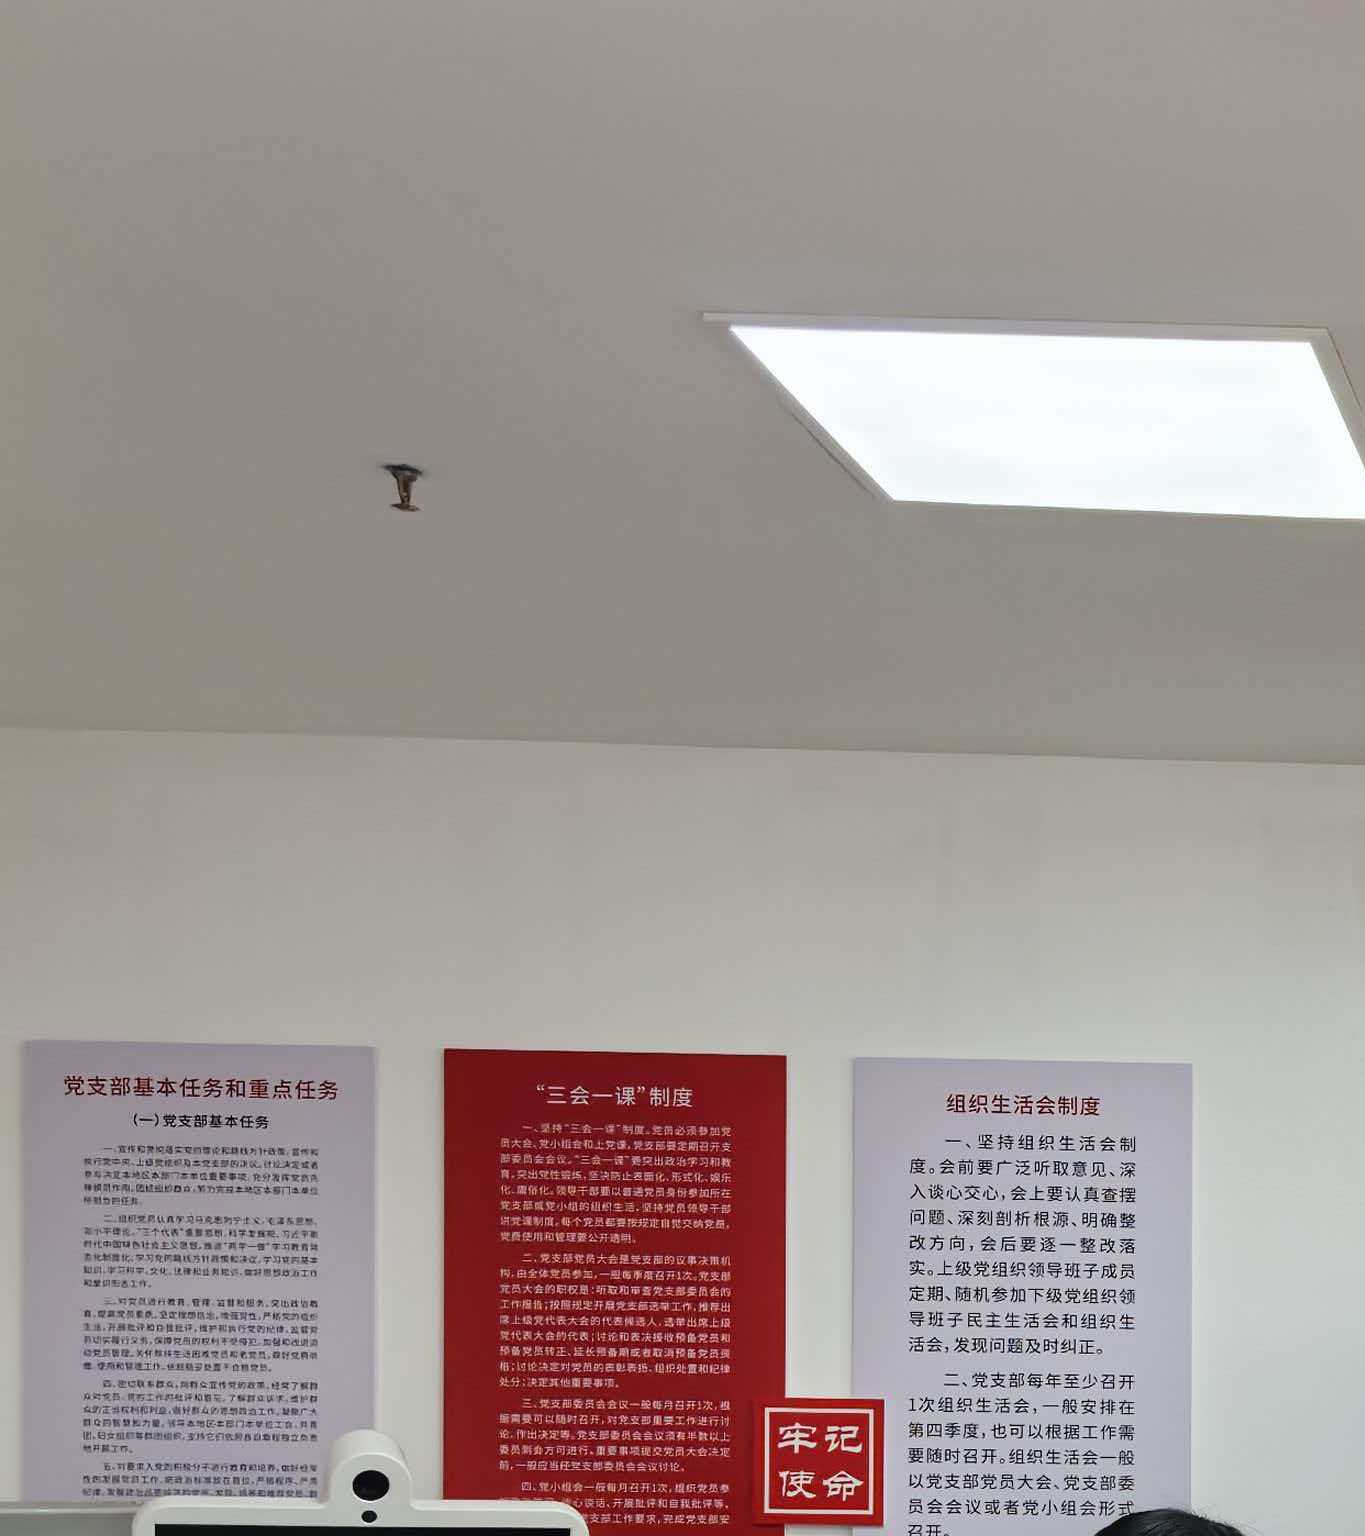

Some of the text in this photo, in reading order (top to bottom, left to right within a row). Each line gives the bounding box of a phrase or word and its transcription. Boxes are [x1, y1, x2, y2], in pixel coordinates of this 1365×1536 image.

[63, 1075, 339, 1101] 党支部基本任务和重点任务
[536, 1084, 693, 1108] “三会一课”制度
[946, 1093, 1101, 1117] 组织生活会制度
[776, 1421, 864, 1455] 牢记
[778, 1469, 865, 1501] 使命
